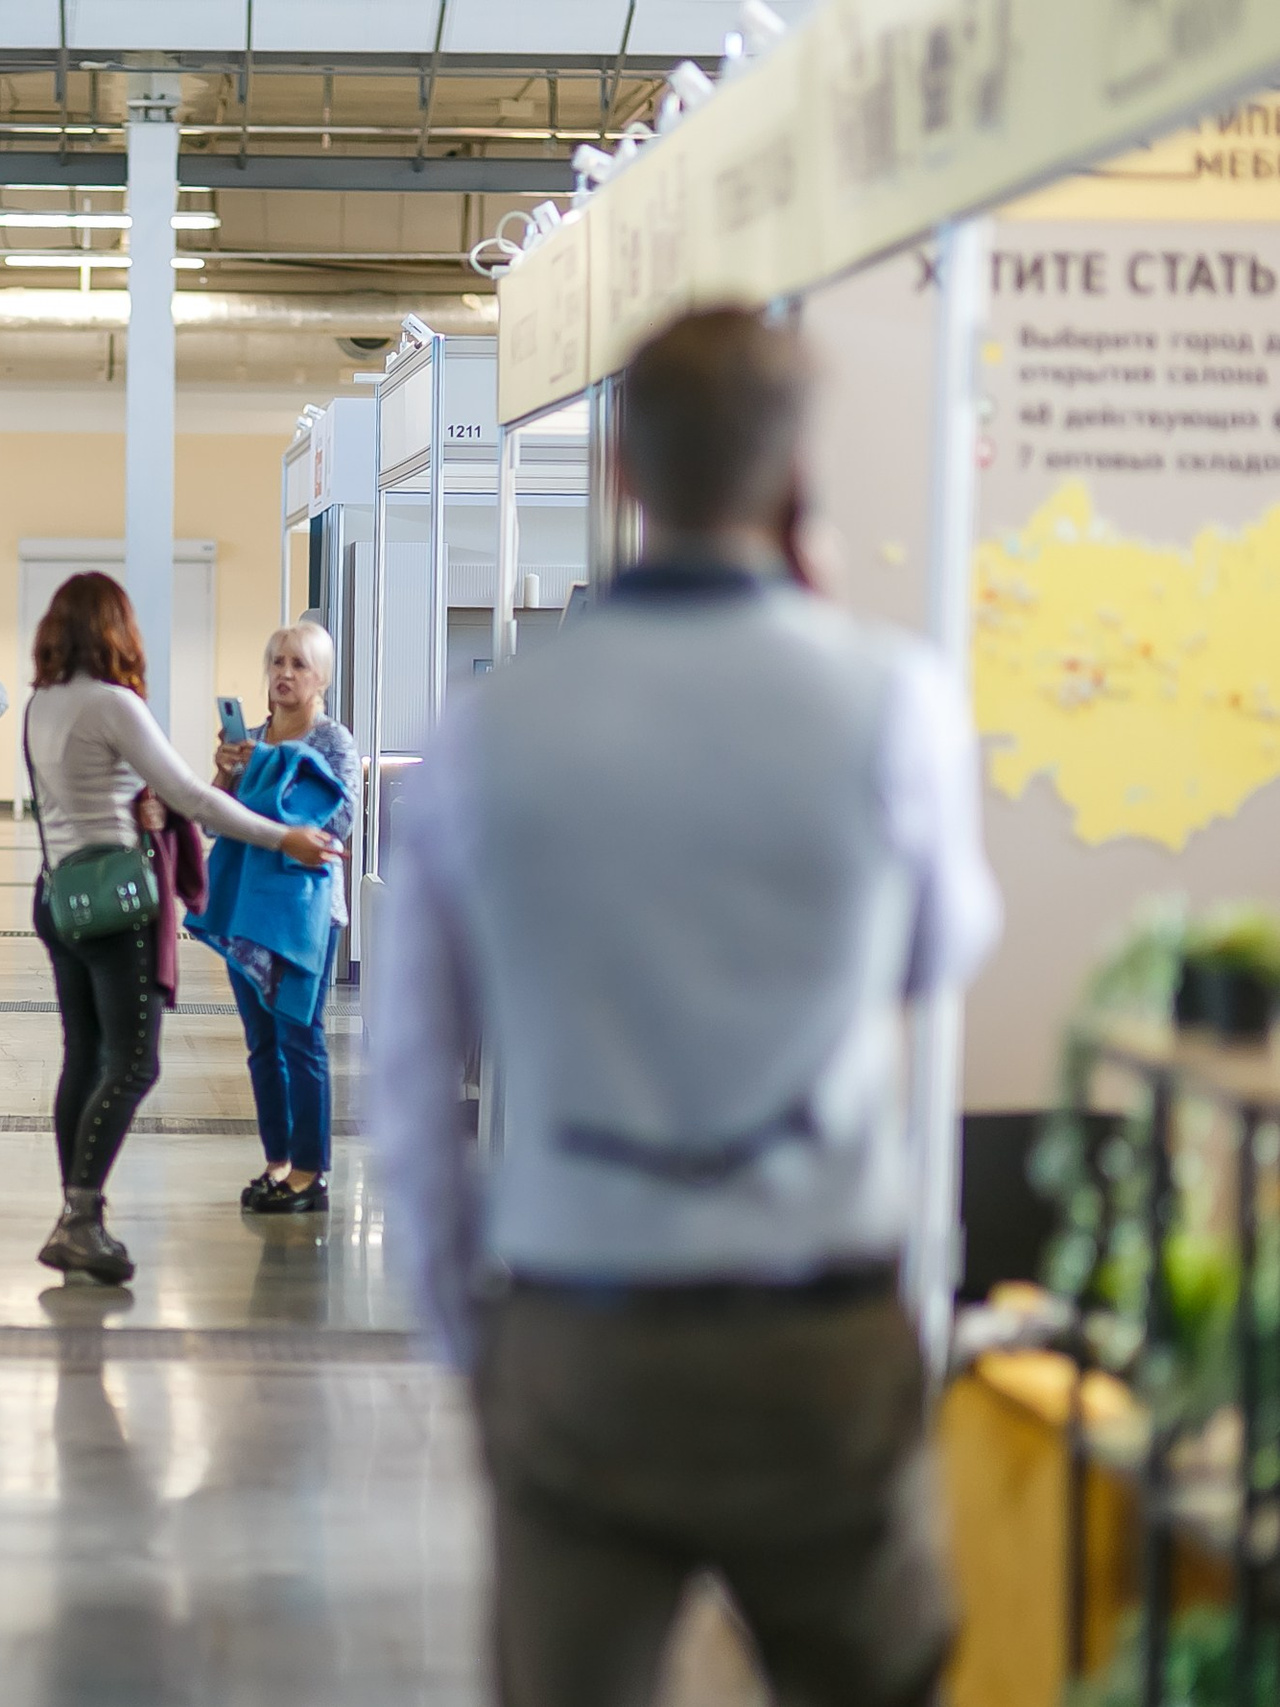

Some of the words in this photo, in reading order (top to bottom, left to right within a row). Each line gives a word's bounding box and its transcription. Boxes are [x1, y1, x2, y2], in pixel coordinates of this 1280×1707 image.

[1195, 152, 1280, 178] МЕБ
[915, 253, 1107, 294] ХТИТЕ
[1128, 252, 1277, 294] СТАТЬ
[447, 424, 482, 438] 1211
[1175, 455, 1280, 472] складо
